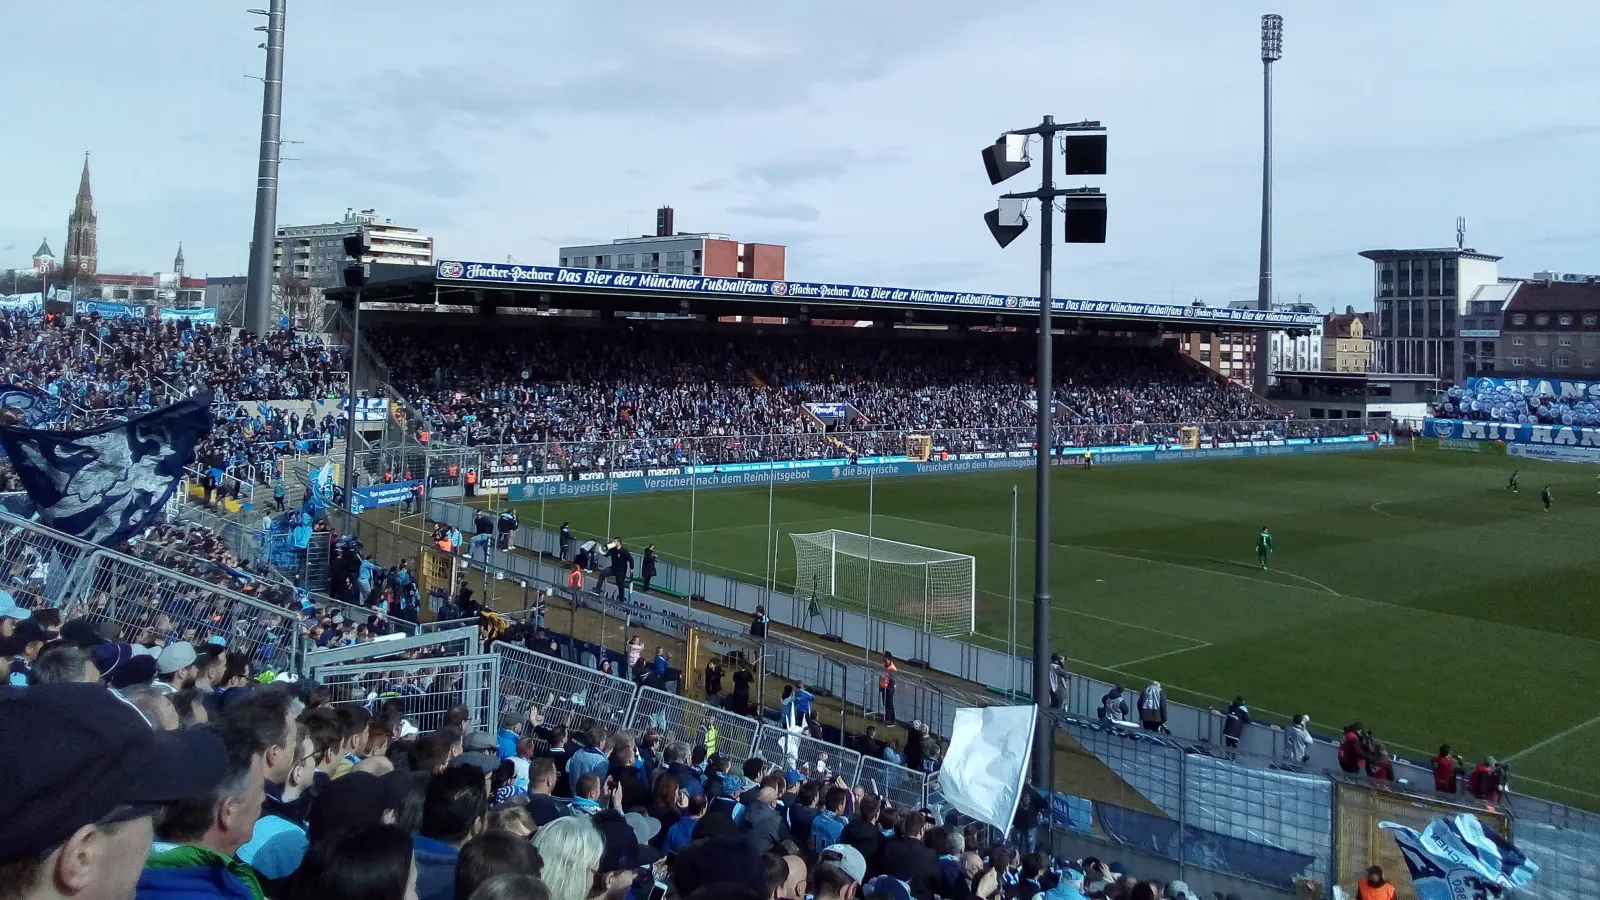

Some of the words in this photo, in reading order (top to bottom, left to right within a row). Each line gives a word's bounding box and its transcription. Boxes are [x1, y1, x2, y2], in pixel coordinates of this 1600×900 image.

[466, 264, 554, 282] Hacker-Pschorr
[557, 269, 582, 283] Das
[584, 270, 612, 285] Bier
[613, 273, 637, 286] der
[639, 273, 700, 290] Münchner
[701, 277, 768, 294] Fußballfans
[789, 284, 850, 298] Hacker-Pschorr
[852, 286, 869, 299] Das
[871, 287, 891, 299] Bier
[892, 289, 909, 300] der
[909, 290, 954, 303] Münchner
[954, 293, 1004, 307] Fußballfans
[1065, 299, 1079, 311] Das
[1079, 300, 1094, 311] Bier
[1095, 301, 1109, 312] der
[1109, 302, 1144, 314] Münchner
[1144, 304, 1182, 317] Fußballfans
[1231, 311, 1241, 320] Das
[1462, 421, 1522, 440] MIT
[959, 451, 982, 460] macron
[984, 450, 1006, 459] macron
[1008, 449, 1031, 458] macron
[842, 465, 855, 477] die
[857, 464, 899, 477] Bayerische
[917, 461, 952, 473] Versichert
[953, 460, 971, 471] nach
[971, 458, 987, 469] dem
[482, 476, 521, 487] macron
[526, 474, 564, 484] macron
[609, 469, 643, 480] macron
[648, 467, 680, 477] macron
[644, 474, 694, 489] Versichert
[696, 473, 719, 485] nach
[720, 471, 742, 483] dem
[743, 468, 811, 483] Reinheitsgebot
[538, 483, 556, 496] die
[559, 479, 619, 495] Bayerische
